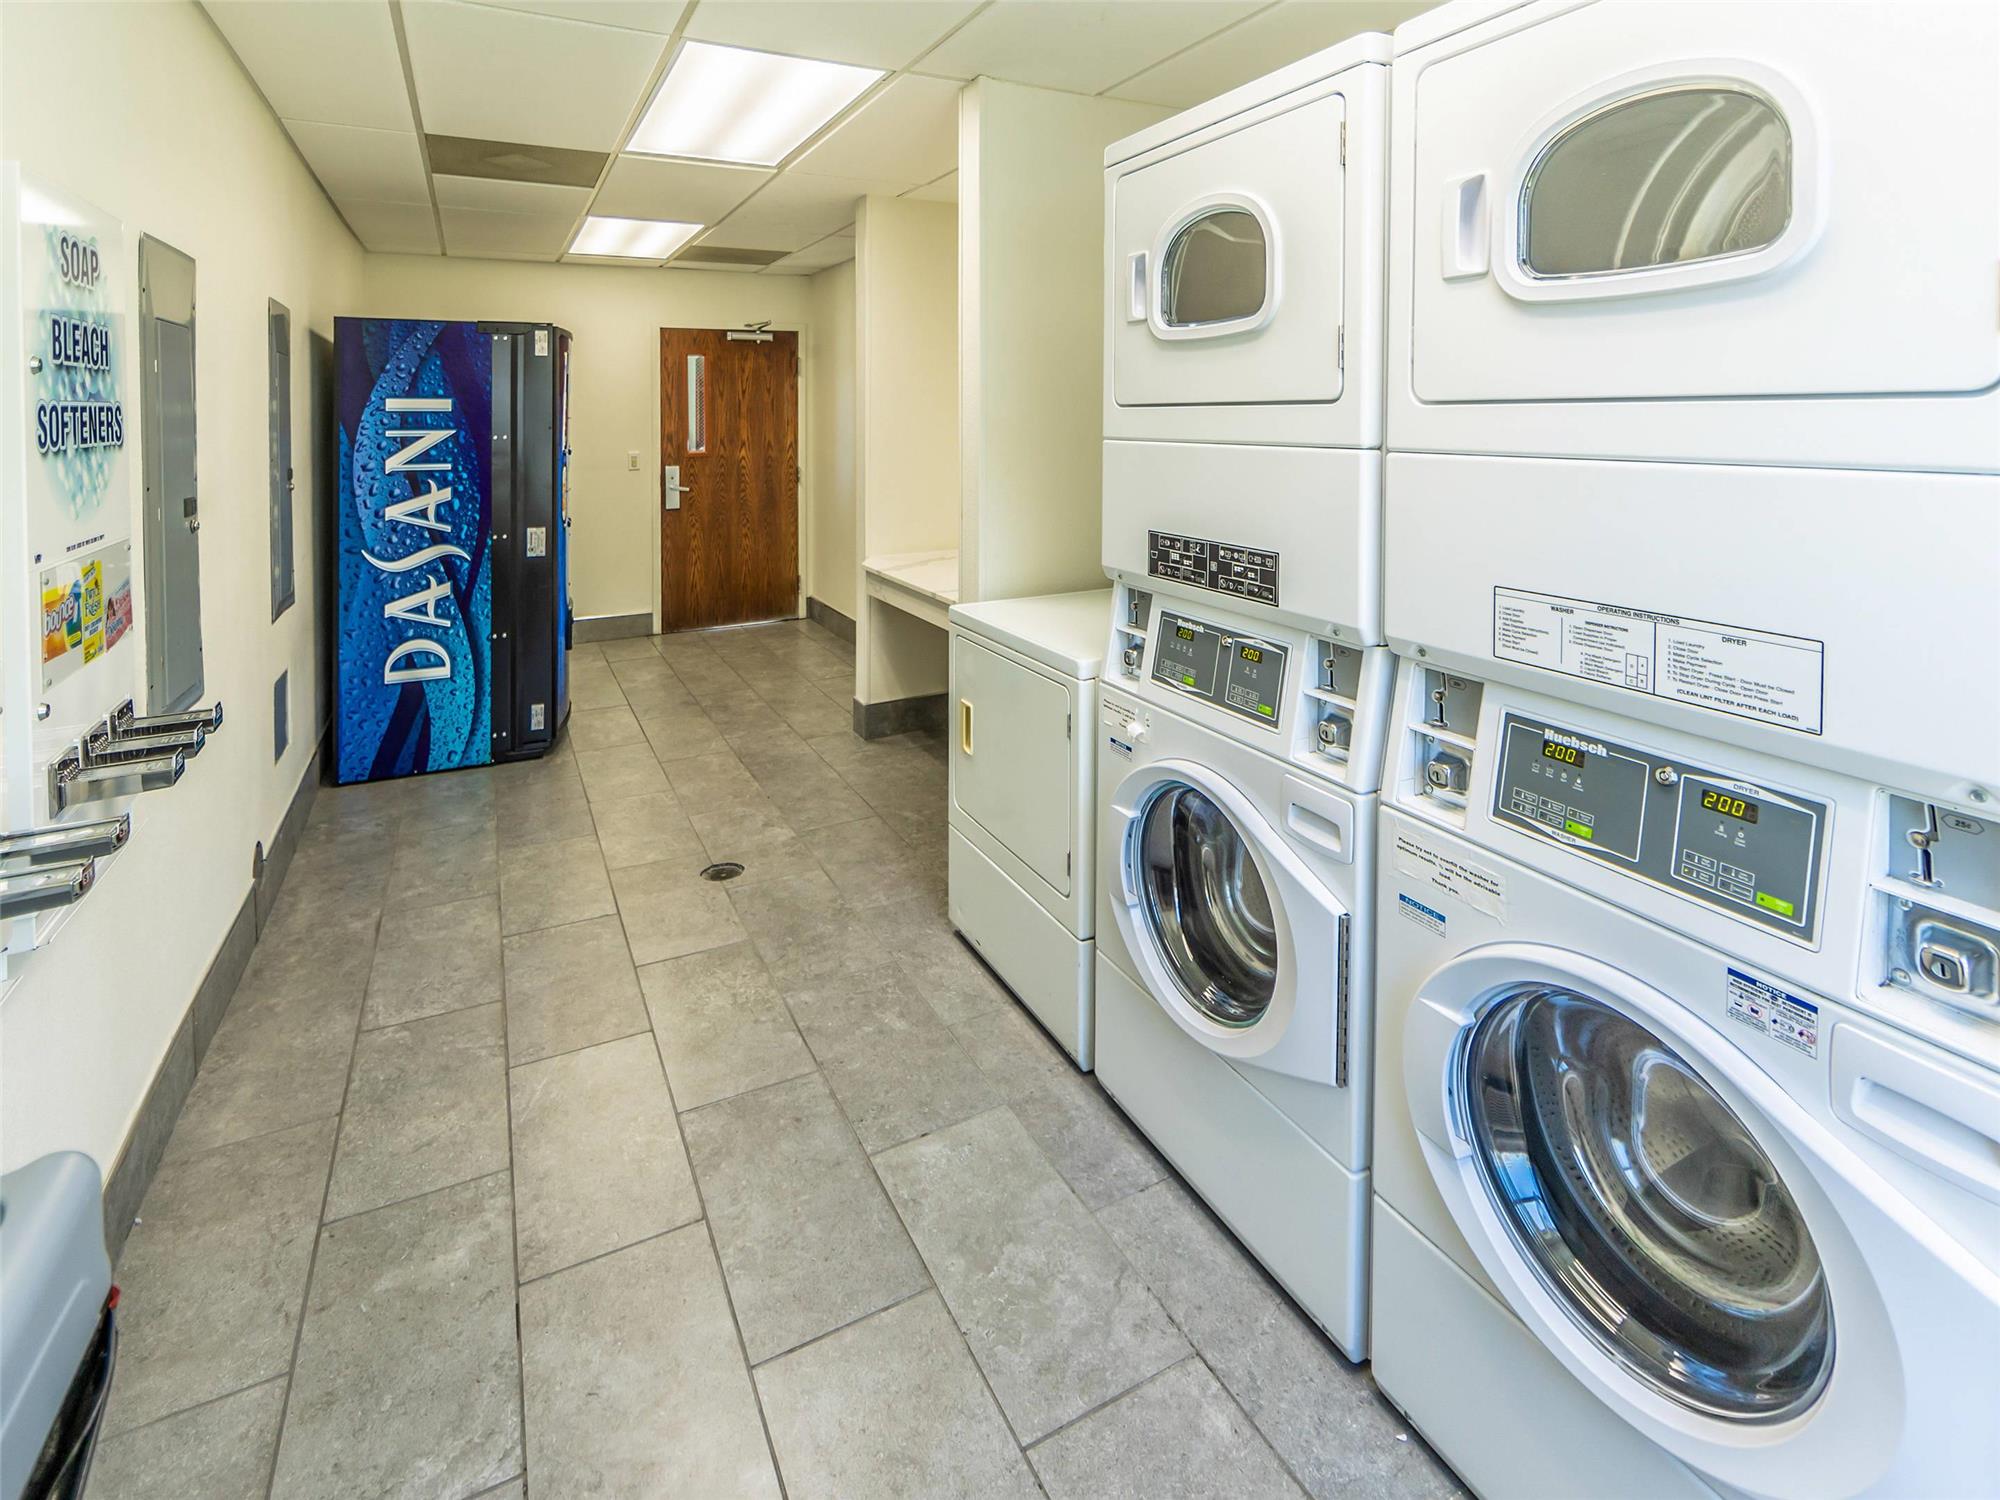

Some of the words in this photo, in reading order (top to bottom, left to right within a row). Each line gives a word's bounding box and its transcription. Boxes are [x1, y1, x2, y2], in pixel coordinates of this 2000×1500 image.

[61, 236, 98, 287] SOAP
[52, 318, 108, 367] BLEACH
[38, 404, 122, 450] SOFTENERS
[361, 398, 471, 684] DASANI
[1550, 606, 1574, 615] WASHER
[1597, 606, 1631, 617] OPERATING
[1632, 612, 1680, 625] INSTRUCTIONS
[1178, 628, 1192, 640] 200
[1722, 636, 1747, 646] DRYER
[1242, 648, 1259, 662] 200
[1676, 688, 1699, 698] (CLEAN
[1714, 696, 1735, 706] FILTER
[1736, 702, 1758, 711] AFTER
[1758, 707, 1777, 716] EACH
[1778, 712, 1799, 722] LOAD)
[1543, 728, 1608, 757] Huebsch
[1545, 742, 1576, 763] 200
[1733, 784, 1760, 796] DRYER
[1704, 792, 1746, 817] 200
[1552, 830, 1576, 844] WASHER
[1756, 982, 1787, 1000] NOTICE
